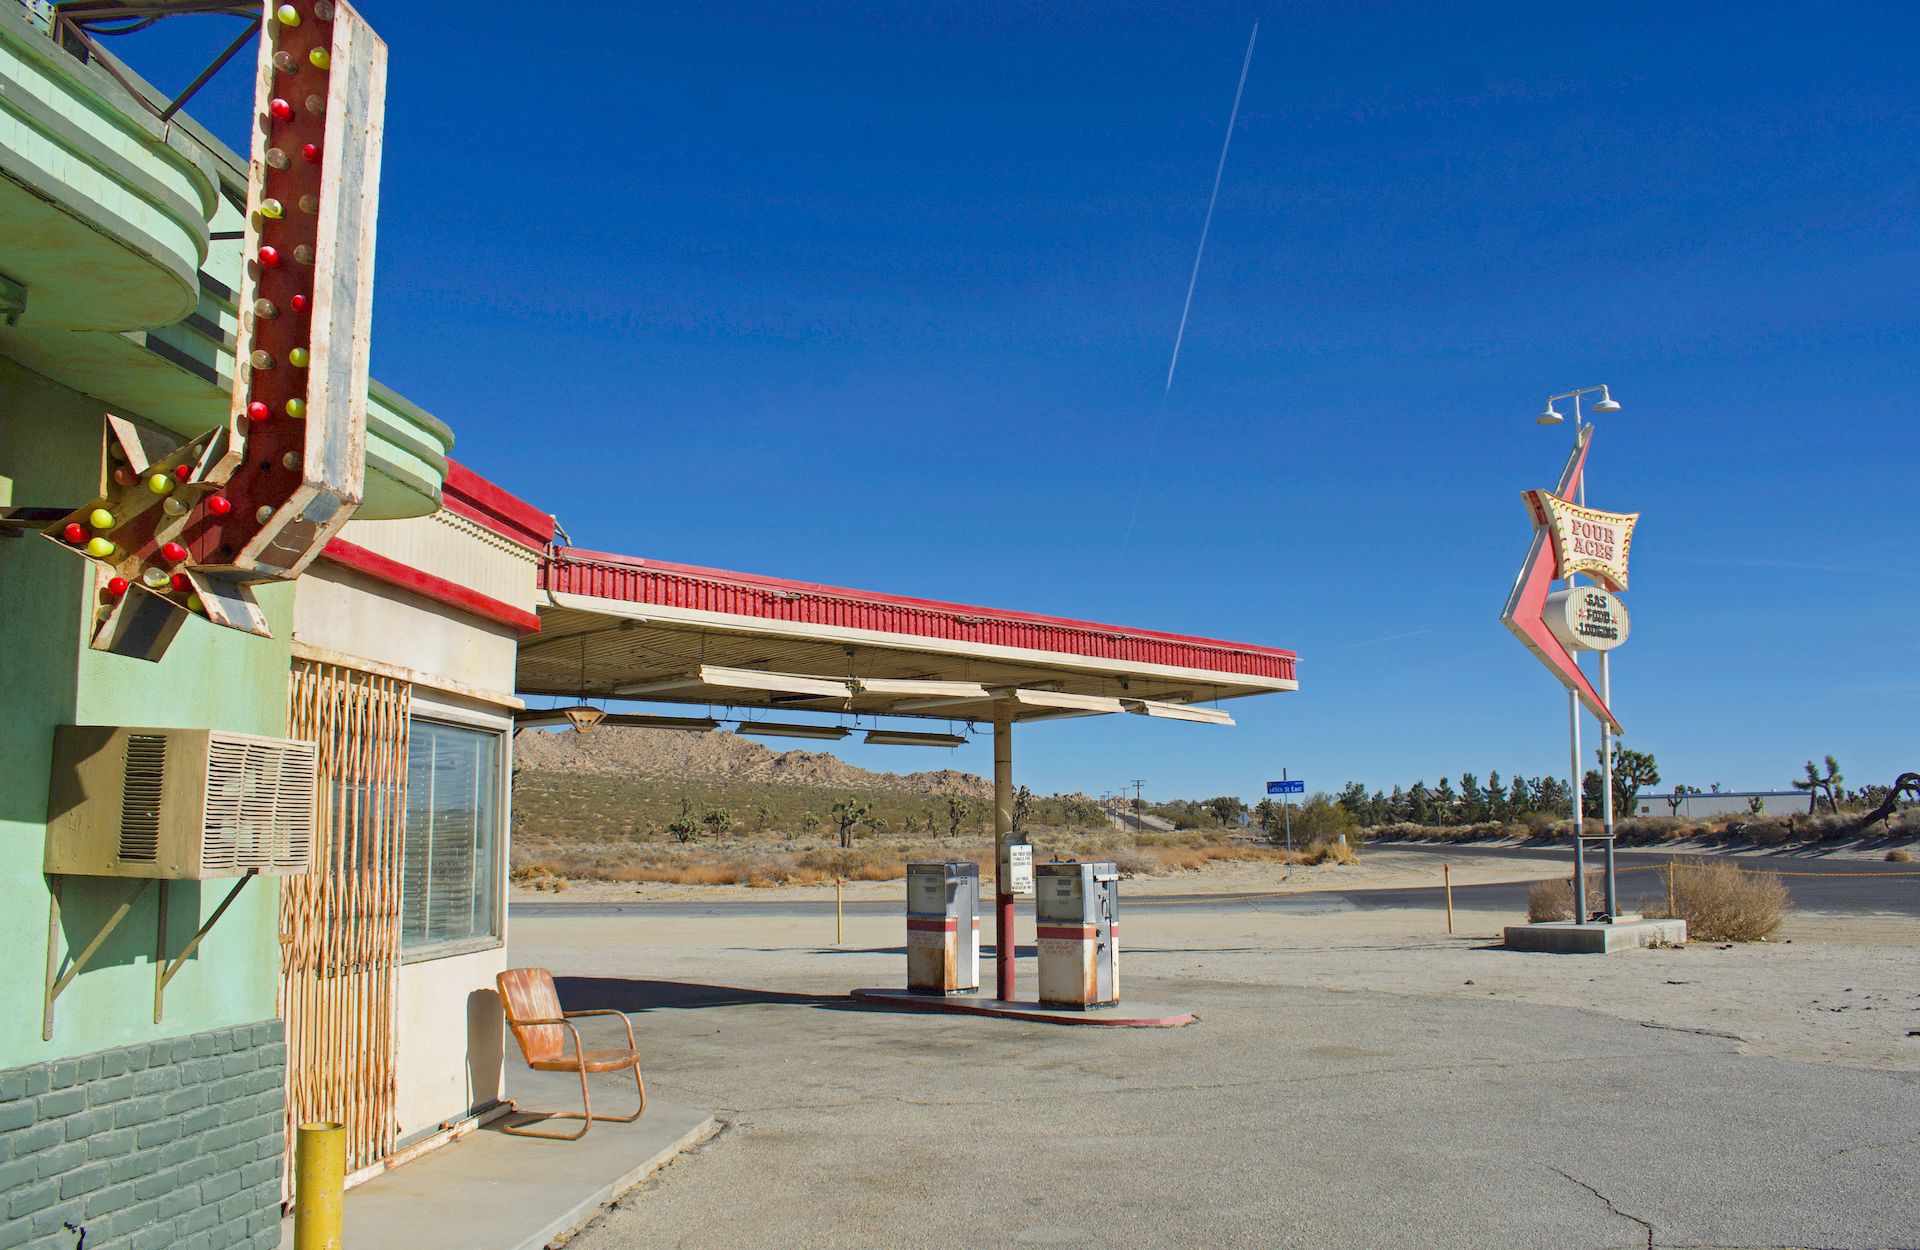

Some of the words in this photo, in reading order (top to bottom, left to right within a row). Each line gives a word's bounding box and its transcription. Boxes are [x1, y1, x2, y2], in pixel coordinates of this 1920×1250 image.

[1571, 519, 1615, 545] FOUR
[1573, 537, 1614, 561] ACES
[1585, 593, 1607, 608] GAS
[1586, 608, 1610, 624] FOOD
